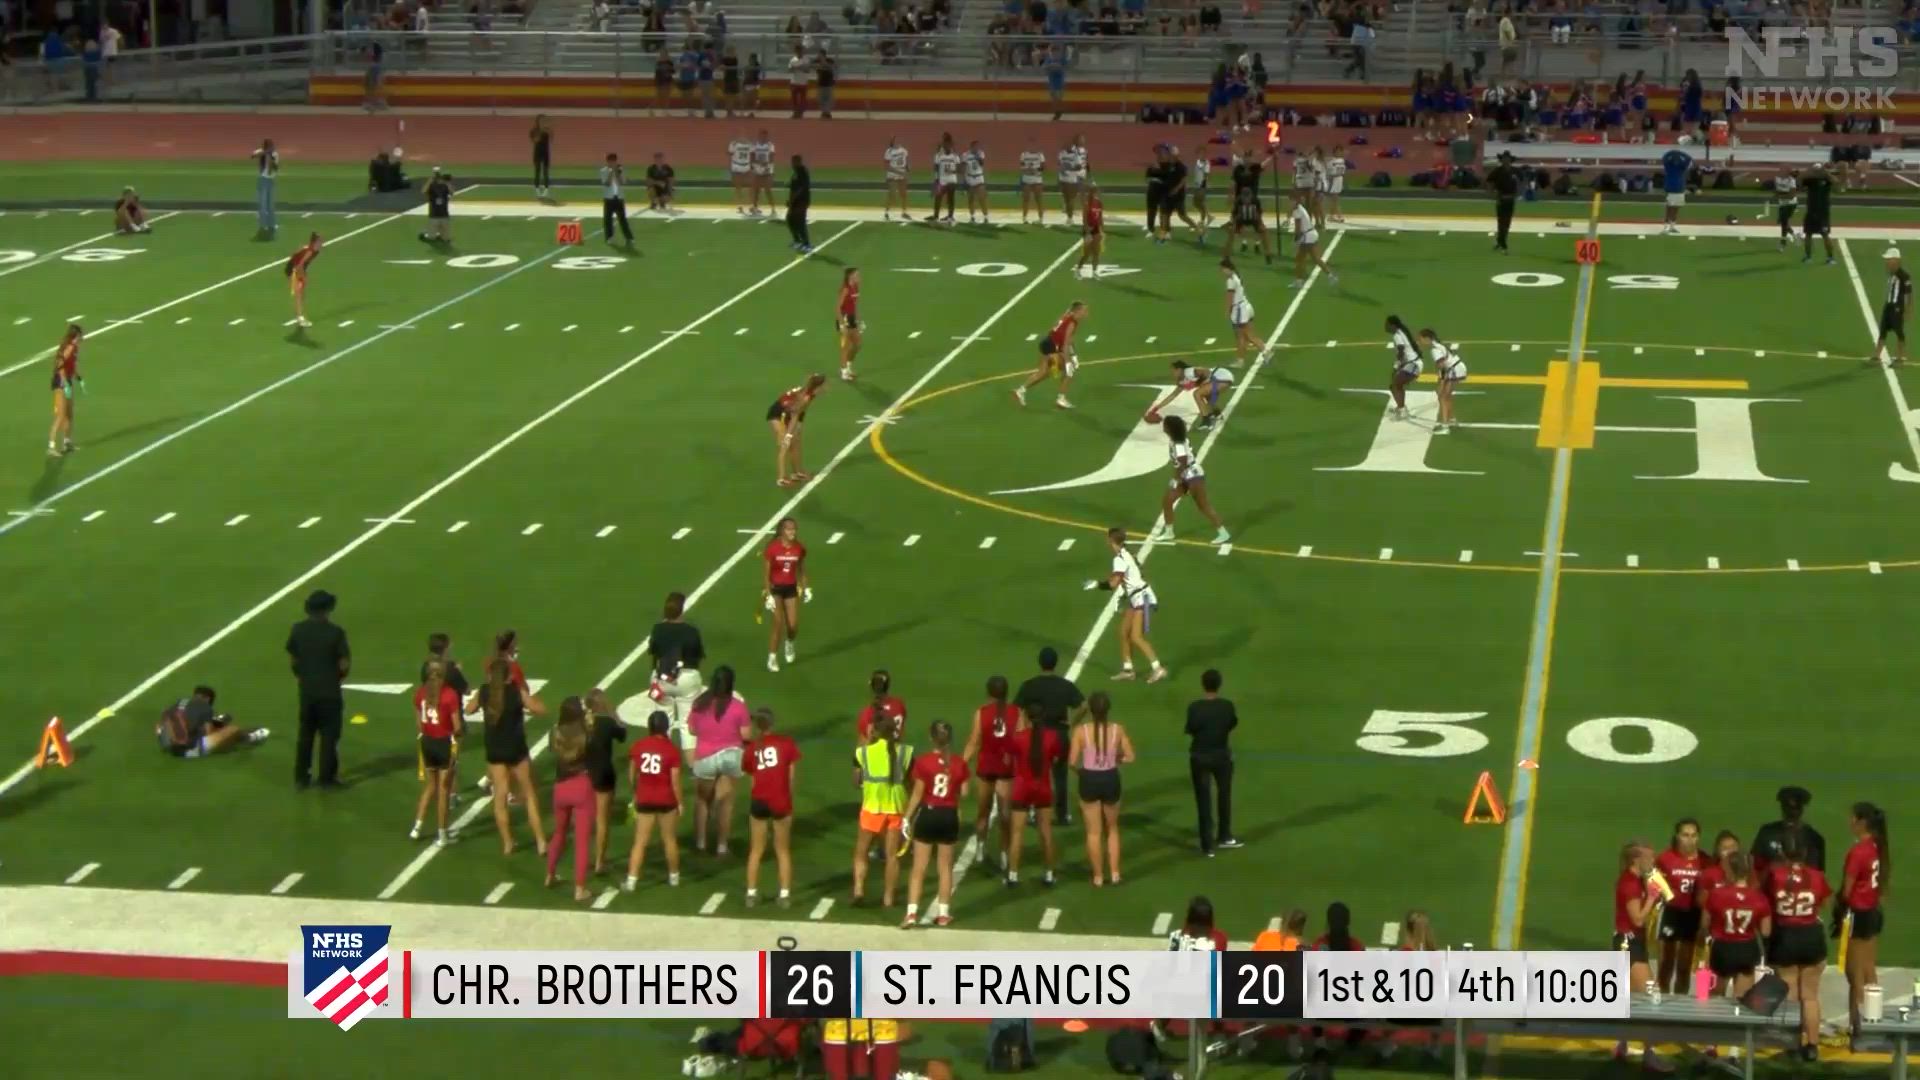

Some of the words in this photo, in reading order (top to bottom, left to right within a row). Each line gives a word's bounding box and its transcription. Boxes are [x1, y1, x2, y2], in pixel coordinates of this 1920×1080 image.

[1267, 121, 1280, 143] 2
[559, 224, 577, 243] 20
[1579, 242, 1598, 261] 40
[640, 752, 661, 775] 26
[754, 746, 778, 770] 19
[932, 773, 949, 798] 8
[1776, 889, 1816, 917] 22
[1724, 908, 1753, 934] 17
